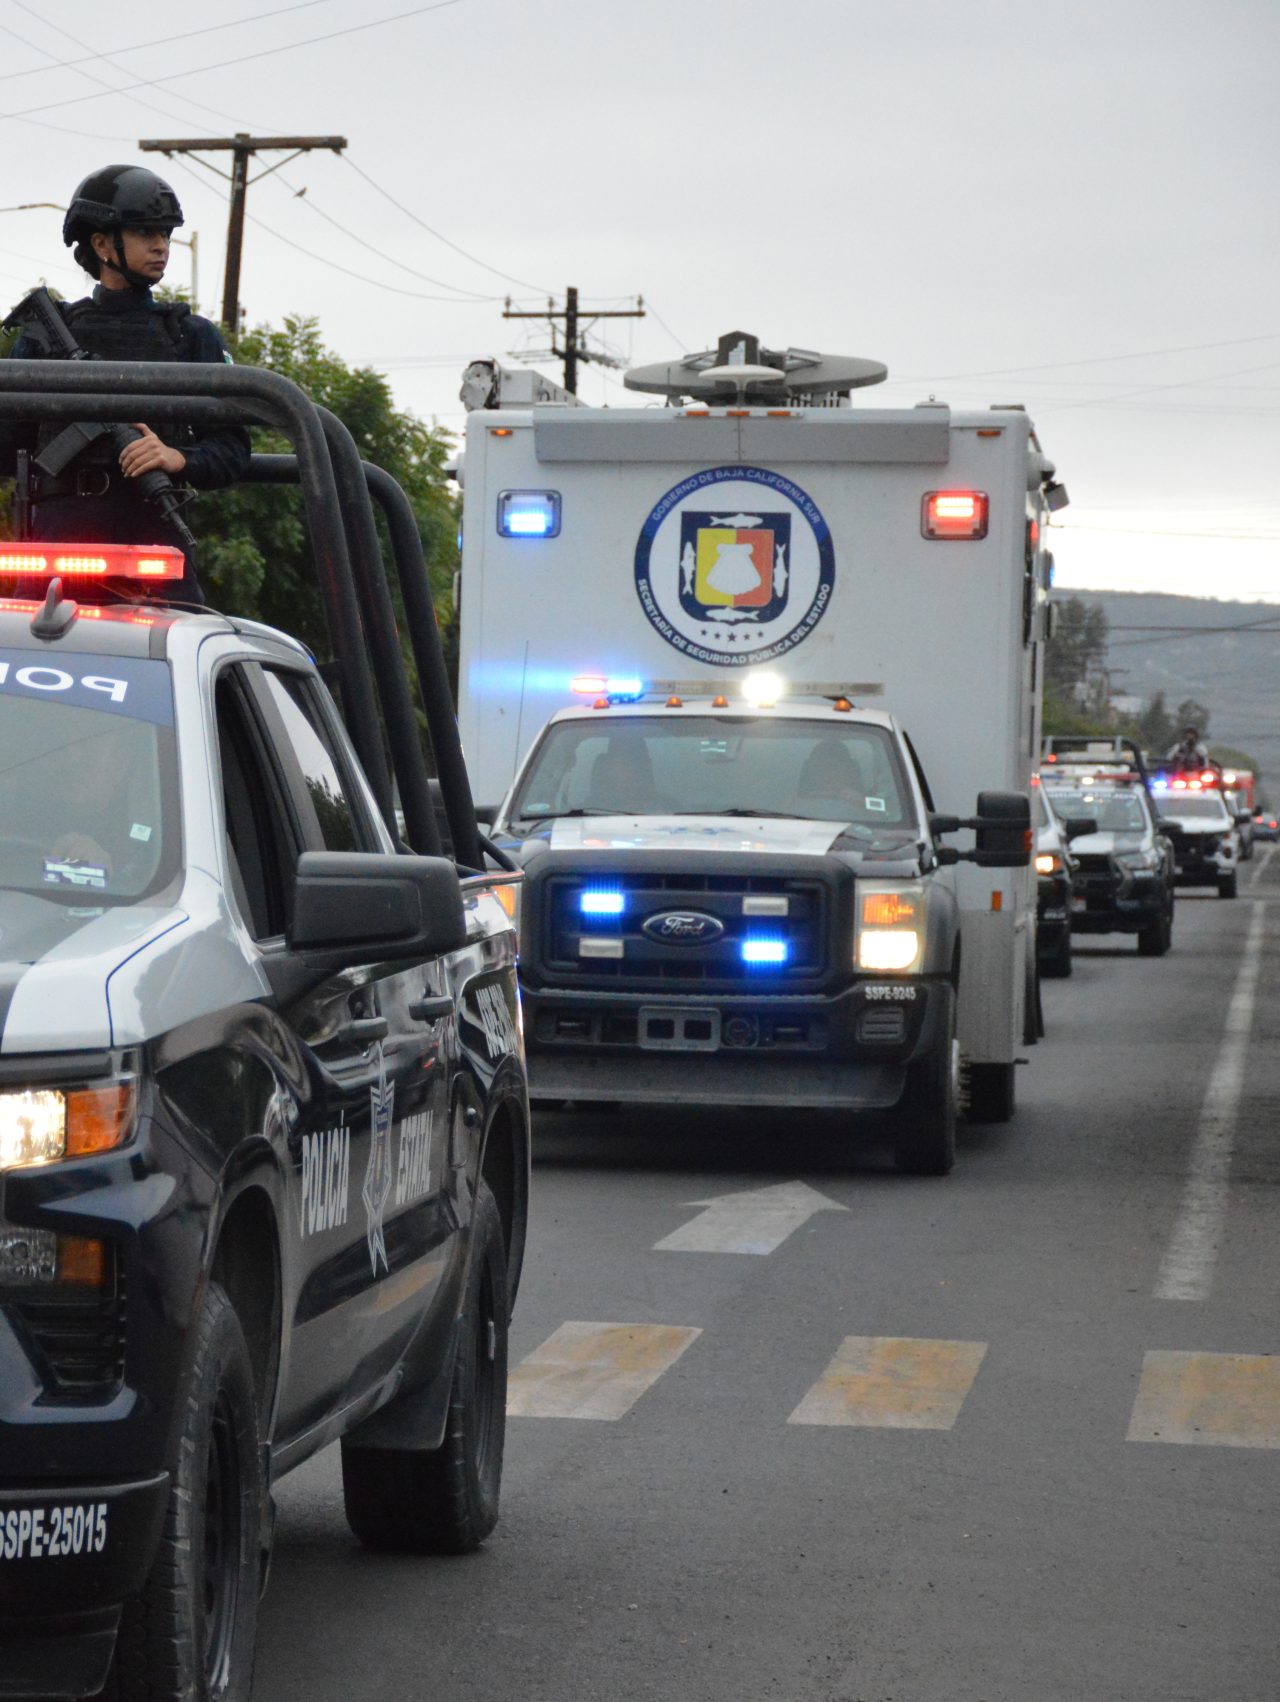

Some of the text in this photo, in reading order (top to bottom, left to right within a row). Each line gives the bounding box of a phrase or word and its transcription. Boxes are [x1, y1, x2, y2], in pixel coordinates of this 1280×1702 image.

[653, 469, 820, 524] GOBIERNO DE BAJA CALIFORNIA SUR
[638, 578, 830, 664] SECRETARÍA DE SEGURIDAD PÚBLICA DEL ESTADO
[661, 916, 705, 935] Ford
[396, 1109, 433, 1206] ESTATAL
